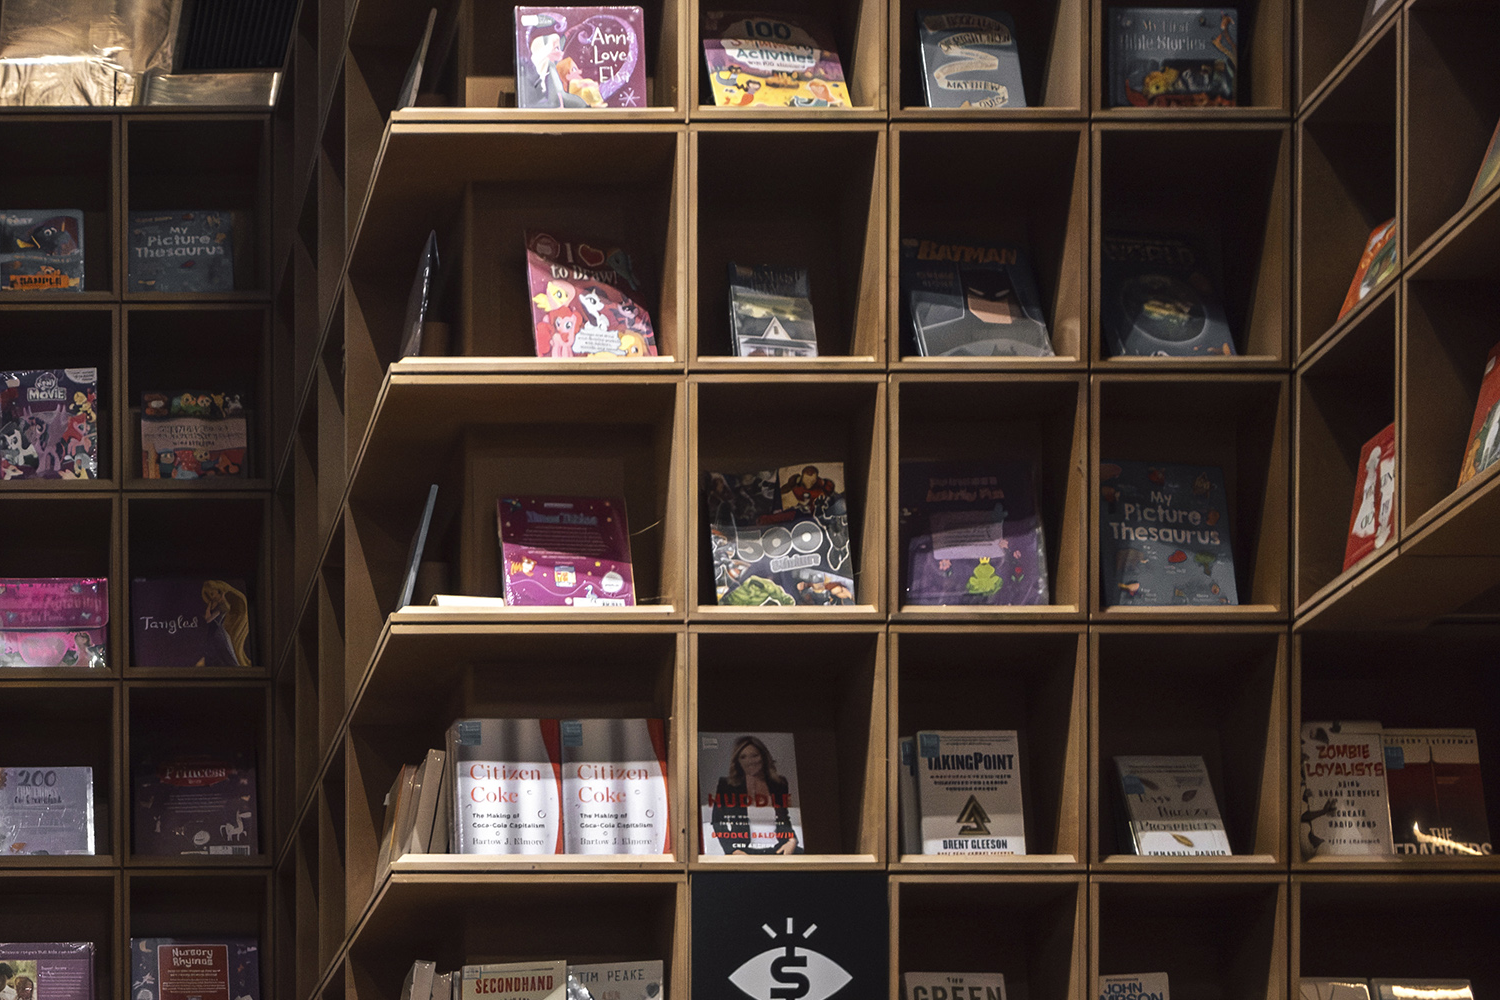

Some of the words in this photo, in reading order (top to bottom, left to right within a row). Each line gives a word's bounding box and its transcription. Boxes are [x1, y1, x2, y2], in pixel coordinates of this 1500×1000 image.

[591, 27, 634, 46] Anna
[745, 21, 791, 40] 100
[593, 49, 634, 65] Loves
[736, 48, 814, 64] Activities
[946, 81, 1000, 92] MATTHEW
[147, 235, 211, 247] Picture
[135, 245, 224, 259] Thesaurus
[917, 241, 1017, 265] BATMAN
[20, 277, 62, 286] SAMPLE
[29, 388, 67, 401] MOVIE
[1150, 491, 1172, 507] My
[1124, 503, 1202, 526] Picture
[1109, 521, 1221, 545] Thesaurus
[140, 616, 198, 634] Tangled
[1316, 744, 1370, 760] ZOMBIE
[164, 767, 226, 780] Princess
[469, 764, 541, 781] Citizen
[577, 764, 649, 781] Citizen
[1306, 762, 1384, 778] LOYALISTS
[17, 770, 57, 787] 200
[470, 787, 518, 803] Coke
[578, 787, 626, 803] Coke
[708, 793, 793, 809] HUDDLE
[510, 822, 545, 830] Capitalism
[617, 822, 653, 830] Capitalism
[942, 839, 968, 850] BRENT
[971, 839, 1008, 850] GLEESON
[172, 948, 213, 959] Nursery
[172, 957, 213, 968] Rhymes
[579, 972, 599, 984] TIM
[607, 969, 645, 982] PEAKE
[475, 975, 554, 995] SECONDHAND
[1104, 982, 1143, 995] JOHN
